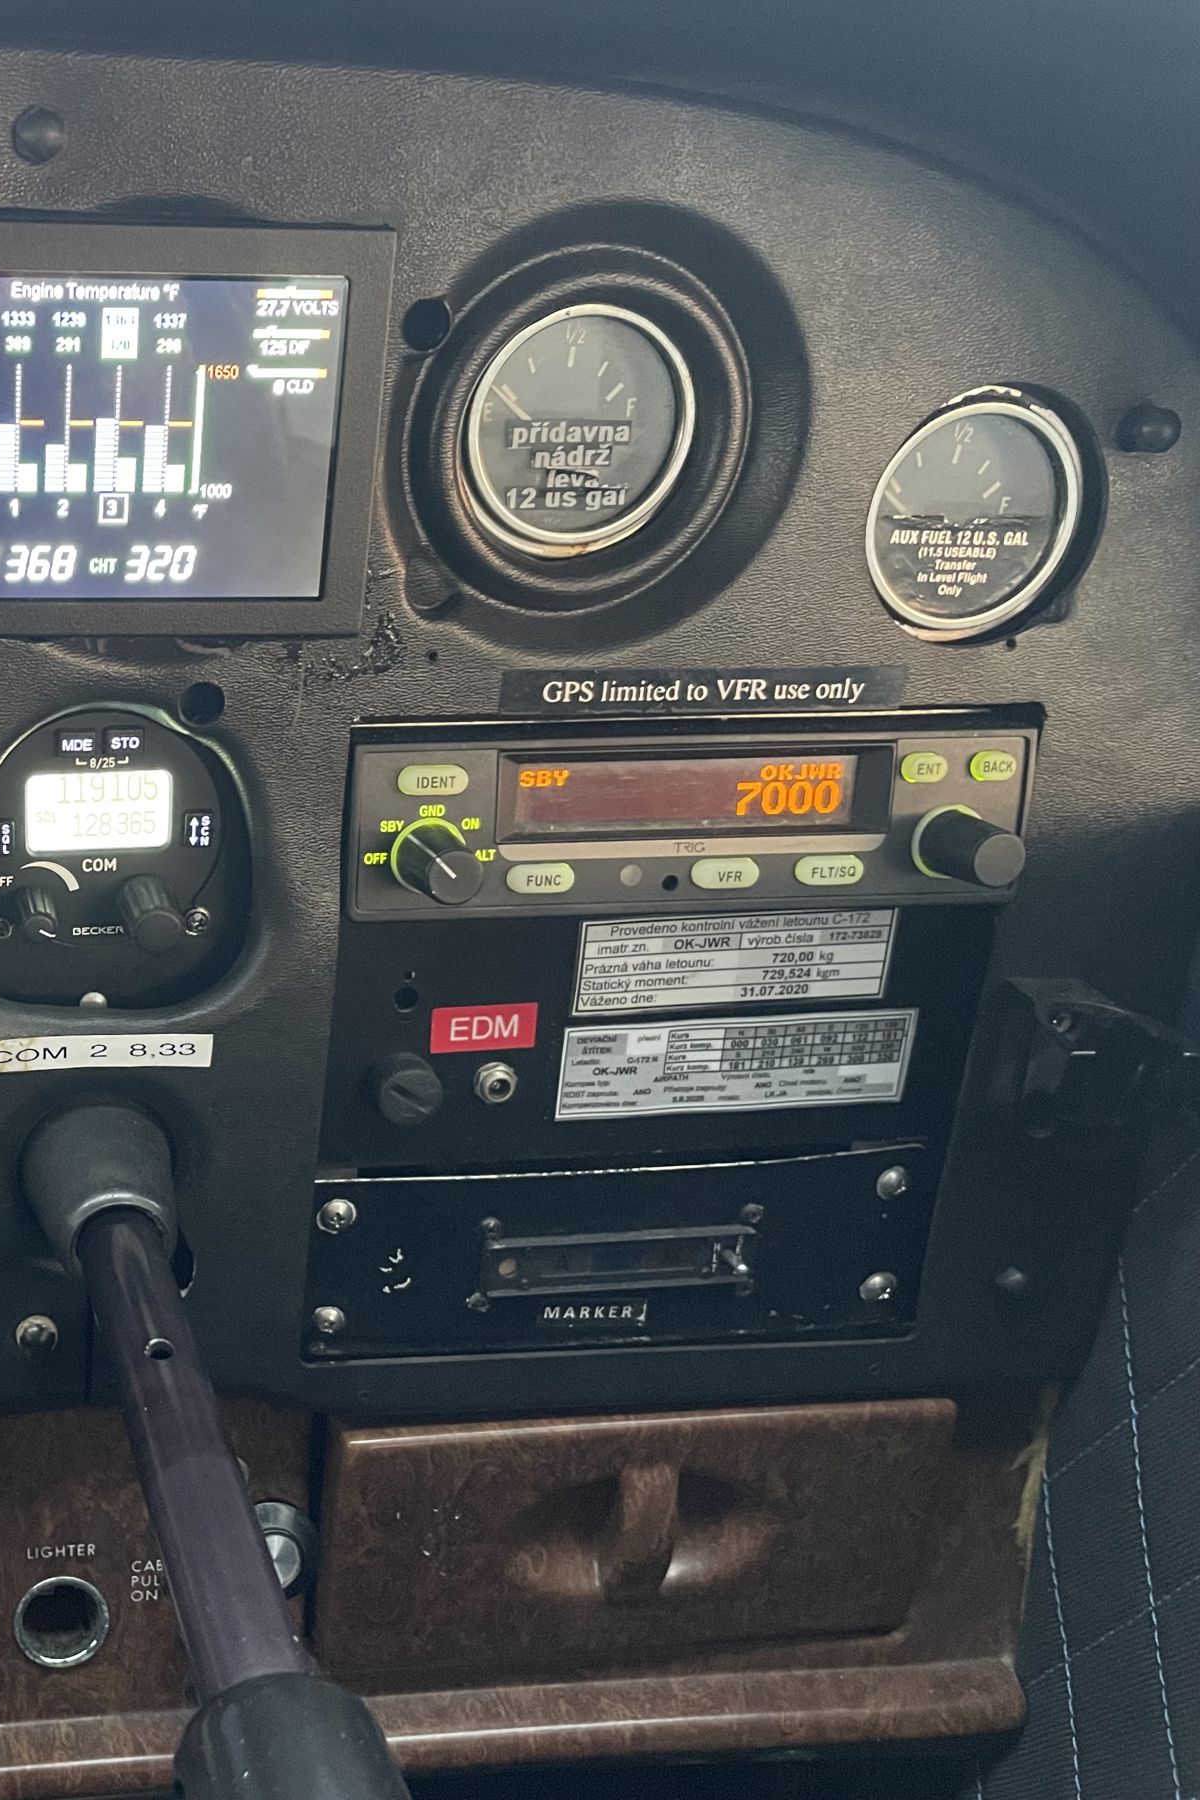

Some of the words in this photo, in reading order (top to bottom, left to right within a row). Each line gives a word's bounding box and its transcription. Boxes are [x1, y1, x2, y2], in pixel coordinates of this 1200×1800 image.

[11, 281, 64, 300] Engine
[65, 282, 160, 302] Temperature
[163, 284, 179, 300] °F
[294, 300, 339, 316] VOLTS
[207, 364, 239, 379] 1650
[535, 444, 610, 468] nádrž
[507, 487, 536, 509] 12
[545, 491, 577, 507] us
[586, 487, 626, 511] gal
[890, 530, 918, 545] AUX
[921, 531, 952, 545] FUEL
[956, 531, 970, 545] 12
[973, 531, 1000, 545] U.S.
[1004, 532, 1029, 545] GAL
[944, 547, 997, 560] USEABLE)
[89, 558, 117, 573] CHT
[124, 544, 198, 583] 320
[935, 560, 977, 571] Transfer
[917, 572, 928, 583] In
[930, 572, 956, 583] Level
[958, 573, 987, 584] Flight
[938, 584, 962, 597] Only
[543, 682, 593, 703] GPS
[601, 680, 680, 703] limited
[687, 682, 708, 702] to
[717, 679, 767, 700] VFR
[774, 681, 809, 700] use
[816, 677, 864, 705] only
[62, 739, 93, 752] MDE
[111, 738, 139, 750] STO
[90, 758, 115, 769] 8/25
[917, 763, 942, 775] ENT
[983, 762, 1013, 773] BACK
[416, 776, 456, 789] IDENT
[519, 770, 570, 787] SBY
[736, 781, 841, 816] 7000
[420, 805, 445, 817] GND
[380, 821, 404, 832] SBY
[82, 858, 117, 872] COM
[364, 853, 387, 865] OFF
[718, 871, 742, 882] VFR
[811, 866, 856, 879] FLT/SQ
[527, 875, 562, 886] FUNC
[611, 924, 678, 936] Provedeno
[682, 919, 734, 932] kontrolní
[739, 913, 779, 929] vážení
[783, 912, 828, 926] letounu
[832, 912, 871, 924] C-172
[72, 926, 124, 936] BECKER
[598, 943, 629, 955] imatr
[632, 943, 648, 953] zn.
[674, 937, 730, 950] OK-JWR
[772, 952, 814, 963] 720,00
[819, 951, 834, 963] kg
[585, 962, 628, 974] Prázná
[633, 959, 661, 971] váha
[666, 957, 714, 969] letounu:
[762, 968, 811, 980] 729,524
[816, 968, 840, 979] kgm
[583, 978, 631, 992] Statický
[635, 975, 688, 987] moment:
[740, 984, 809, 997] 31.07.2020
[581, 993, 627, 1007] Váženo
[631, 993, 656, 1004] dne:
[450, 1014, 519, 1041] EDM
[90, 1045, 107, 1058] 2
[130, 1043, 196, 1058] 8,33
[593, 1067, 638, 1075] OK-JWR
[543, 1304, 633, 1320] MARKER
[27, 1544, 96, 1559] LIGHTER
